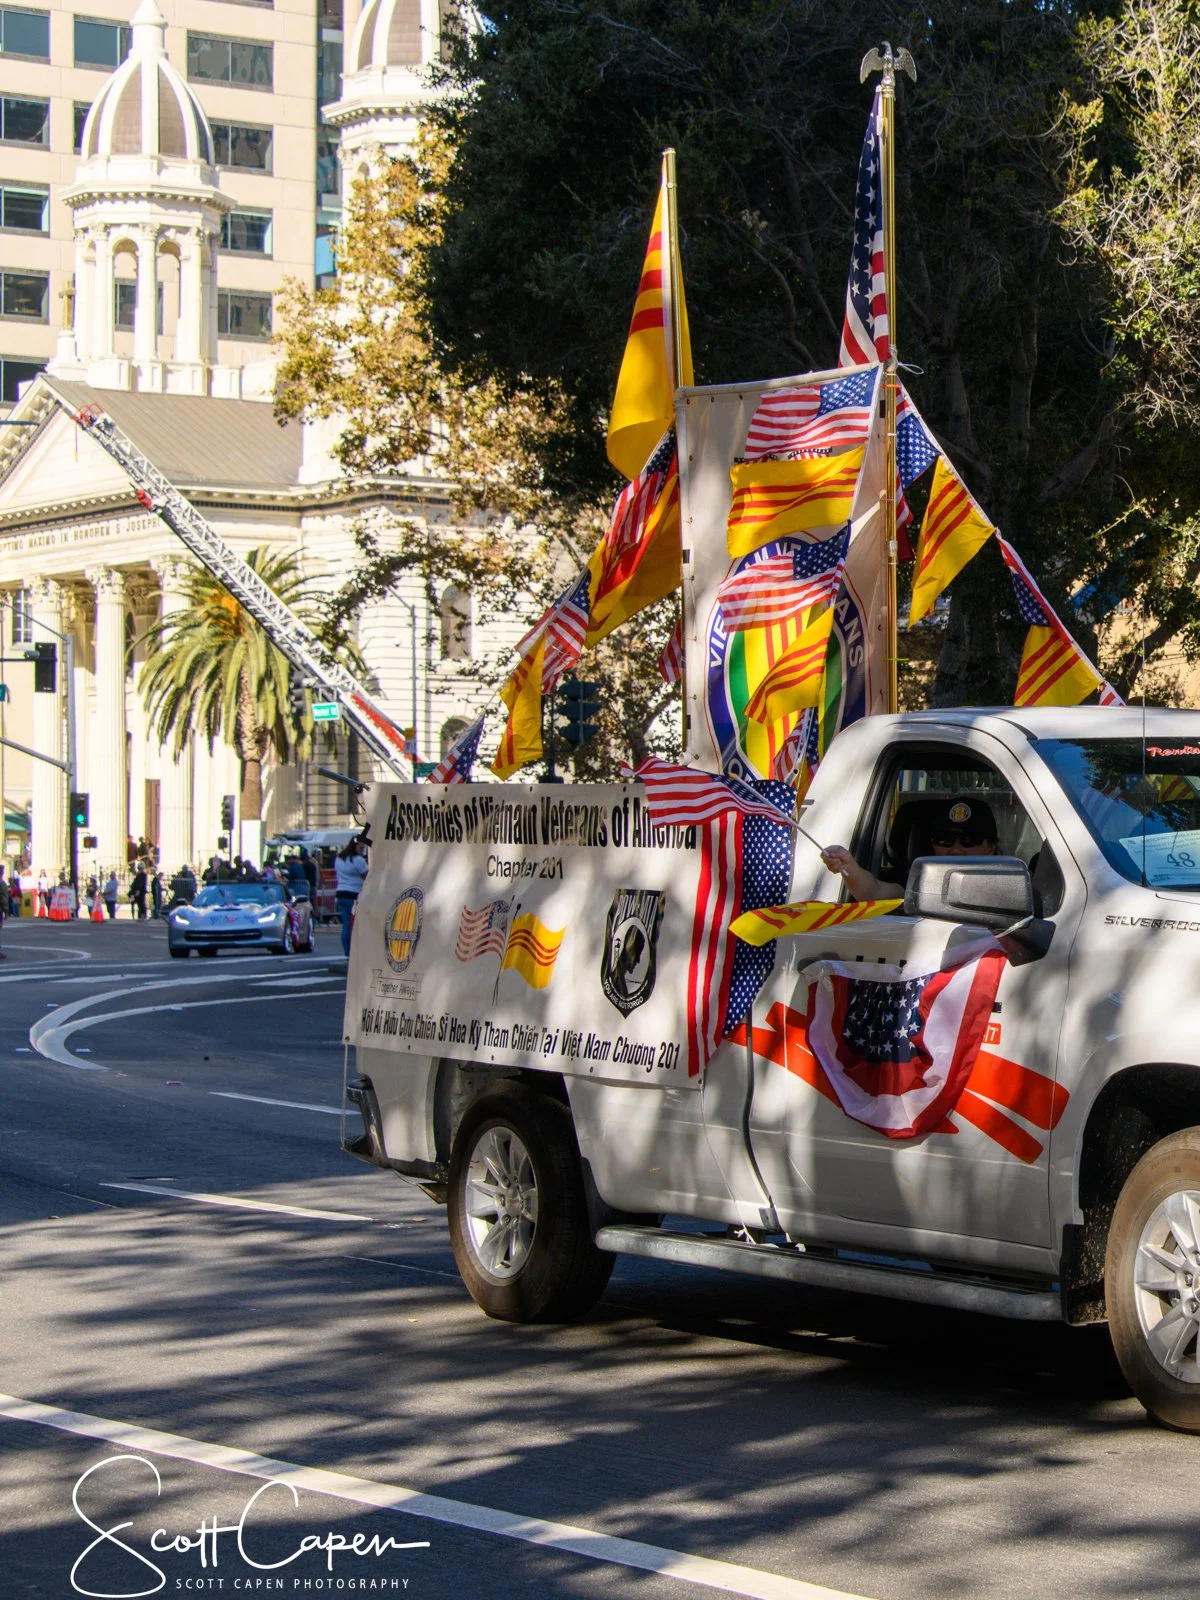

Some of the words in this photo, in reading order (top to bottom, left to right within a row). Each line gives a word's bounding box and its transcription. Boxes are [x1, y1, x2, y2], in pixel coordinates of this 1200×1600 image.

[385, 794, 464, 844] Associates
[463, 796, 479, 844] of
[479, 796, 538, 845] Vietnam
[541, 796, 608, 848] Veterans
[611, 797, 629, 848] of
[487, 854, 539, 883] Chapter
[539, 856, 563, 880] 201
[1166, 852, 1196, 868] 48
[603, 979, 611, 995] YOU
[449, 1017, 467, 1043] Hoa
[468, 1018, 482, 1051] Kỳ
[482, 1021, 509, 1049] Tham
[511, 1023, 539, 1051] Chiến
[538, 1027, 560, 1058] Tại
[560, 1028, 583, 1061] Việt
[583, 1032, 612, 1061] Nam
[657, 1041, 681, 1070] 201
